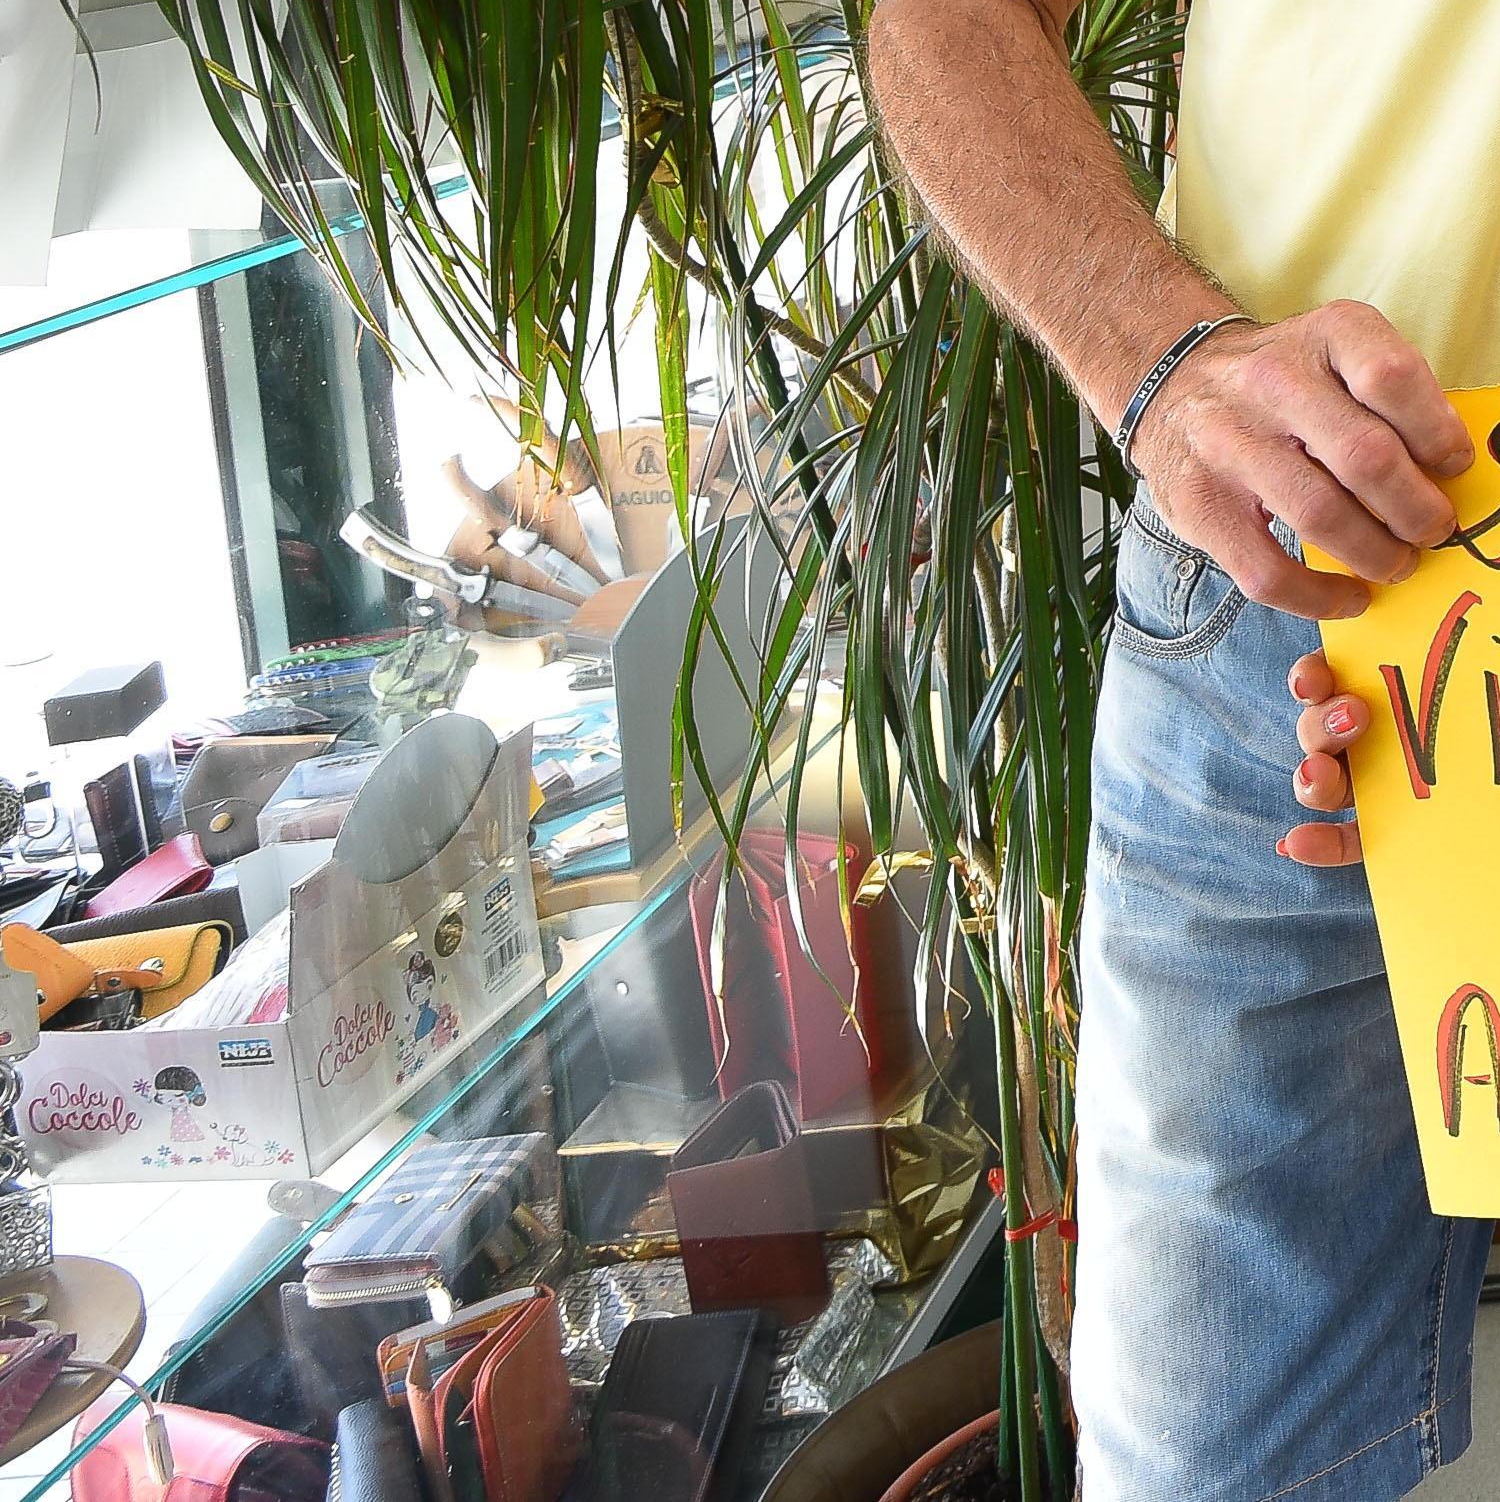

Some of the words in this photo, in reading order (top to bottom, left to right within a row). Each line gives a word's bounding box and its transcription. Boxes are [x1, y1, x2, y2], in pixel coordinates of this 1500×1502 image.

[334, 1002, 376, 1042] Dolci
[315, 1010, 397, 1090] Coccole
[49, 1080, 109, 1110] Dolci
[27, 1098, 144, 1136] Coccole
